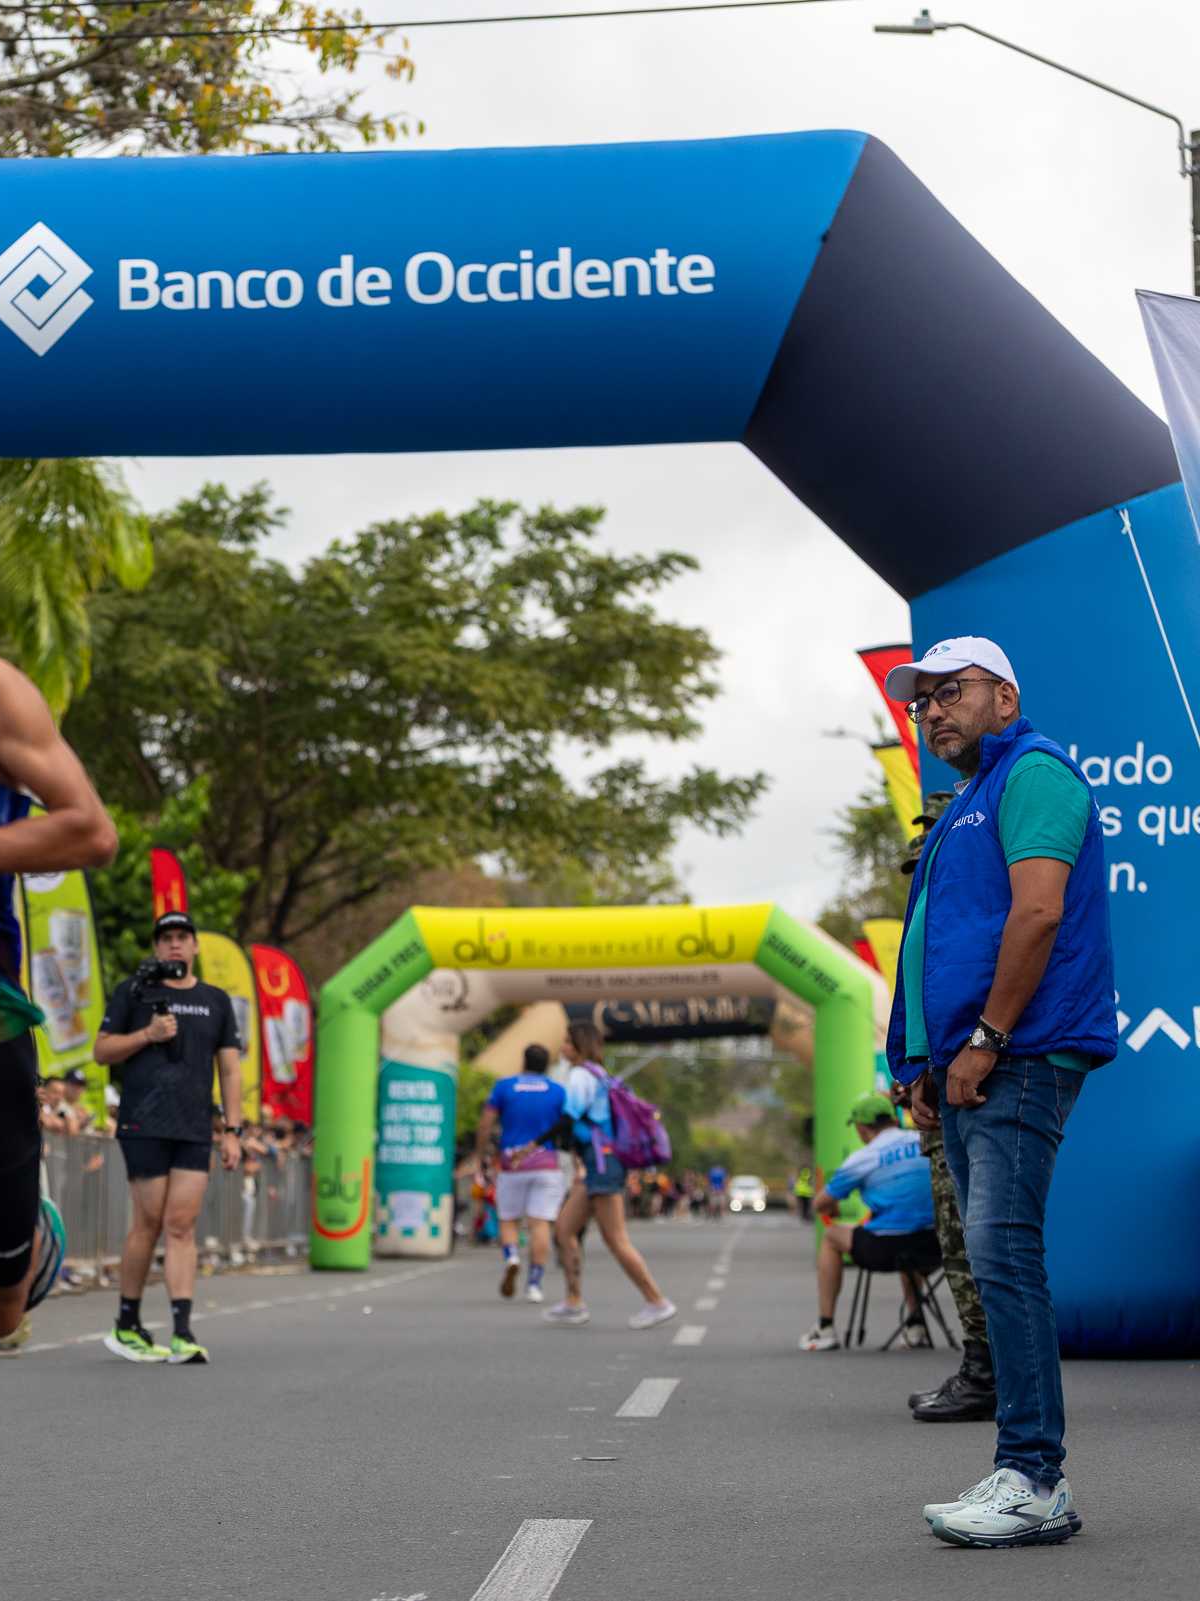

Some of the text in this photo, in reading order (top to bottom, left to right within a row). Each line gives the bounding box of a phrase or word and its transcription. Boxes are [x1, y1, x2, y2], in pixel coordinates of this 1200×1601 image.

[118, 247, 715, 311] Banco de Occidente
